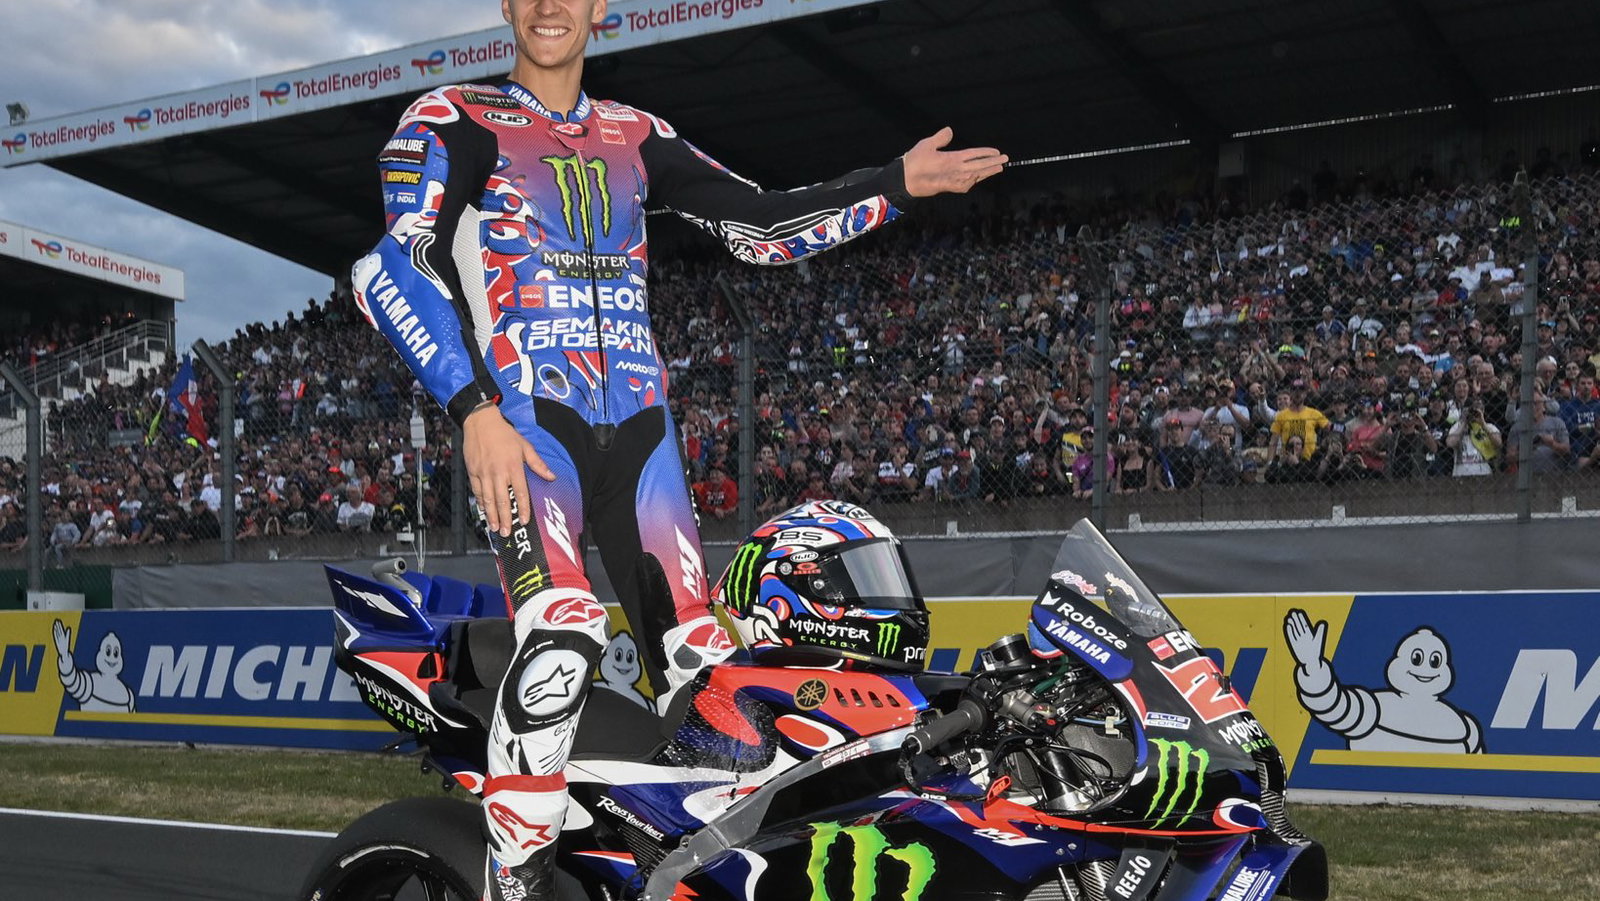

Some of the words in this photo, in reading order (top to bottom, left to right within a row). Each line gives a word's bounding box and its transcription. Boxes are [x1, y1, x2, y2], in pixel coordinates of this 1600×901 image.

[626, 0, 763, 32] TotalEnergies
[448, 39, 515, 68] TotalEn
[293, 63, 401, 99] TotalEnergies
[153, 93, 250, 126] TotalEnergies
[490, 113, 523, 123] HJC
[508, 86, 552, 118] YAMAHA
[28, 118, 115, 149] TotalEnergies
[396, 195, 417, 204] INDIA
[65, 245, 161, 284] TotalEnergies
[543, 251, 630, 269] MONSTER
[559, 270, 621, 279] ENERGY
[547, 285, 645, 312] ENEOS
[370, 270, 438, 368] YAMAHA
[779, 530, 823, 542] BS
[789, 619, 871, 643] MONSTER
[1045, 619, 1112, 665] YAMAHA
[1057, 602, 1128, 650] Roboze
[800, 635, 858, 650] ENERGY
[354, 671, 438, 733] MONSTER
[368, 693, 425, 734] ENERGY
[596, 795, 629, 817] Revs
[625, 812, 646, 829] Your
[643, 823, 665, 839] Heart
